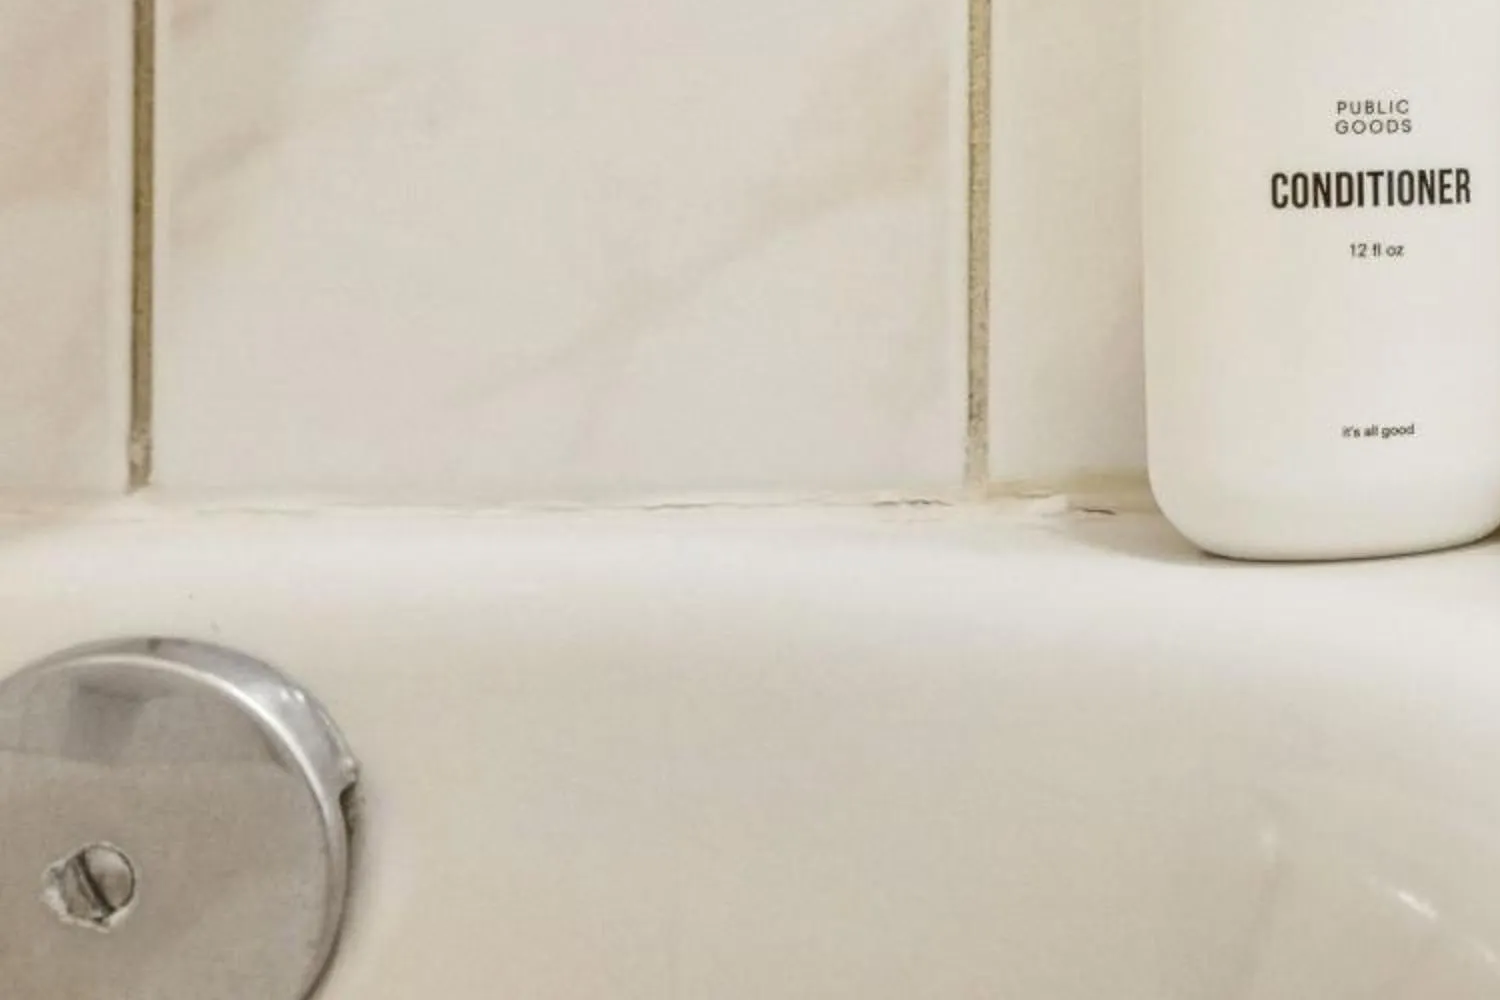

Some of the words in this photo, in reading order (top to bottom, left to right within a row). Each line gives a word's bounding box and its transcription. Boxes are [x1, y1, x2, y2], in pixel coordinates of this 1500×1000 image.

[1337, 99, 1409, 115] PUBLIC
[1335, 119, 1412, 135] GOODS
[1271, 168, 1471, 210] CONDITIONER
[1350, 242, 1367, 258] 12
[1371, 241, 1382, 257] fl
[1385, 244, 1405, 258] oz
[1341, 424, 1361, 438] it's
[1363, 423, 1379, 437] all
[1381, 422, 1416, 439] good
